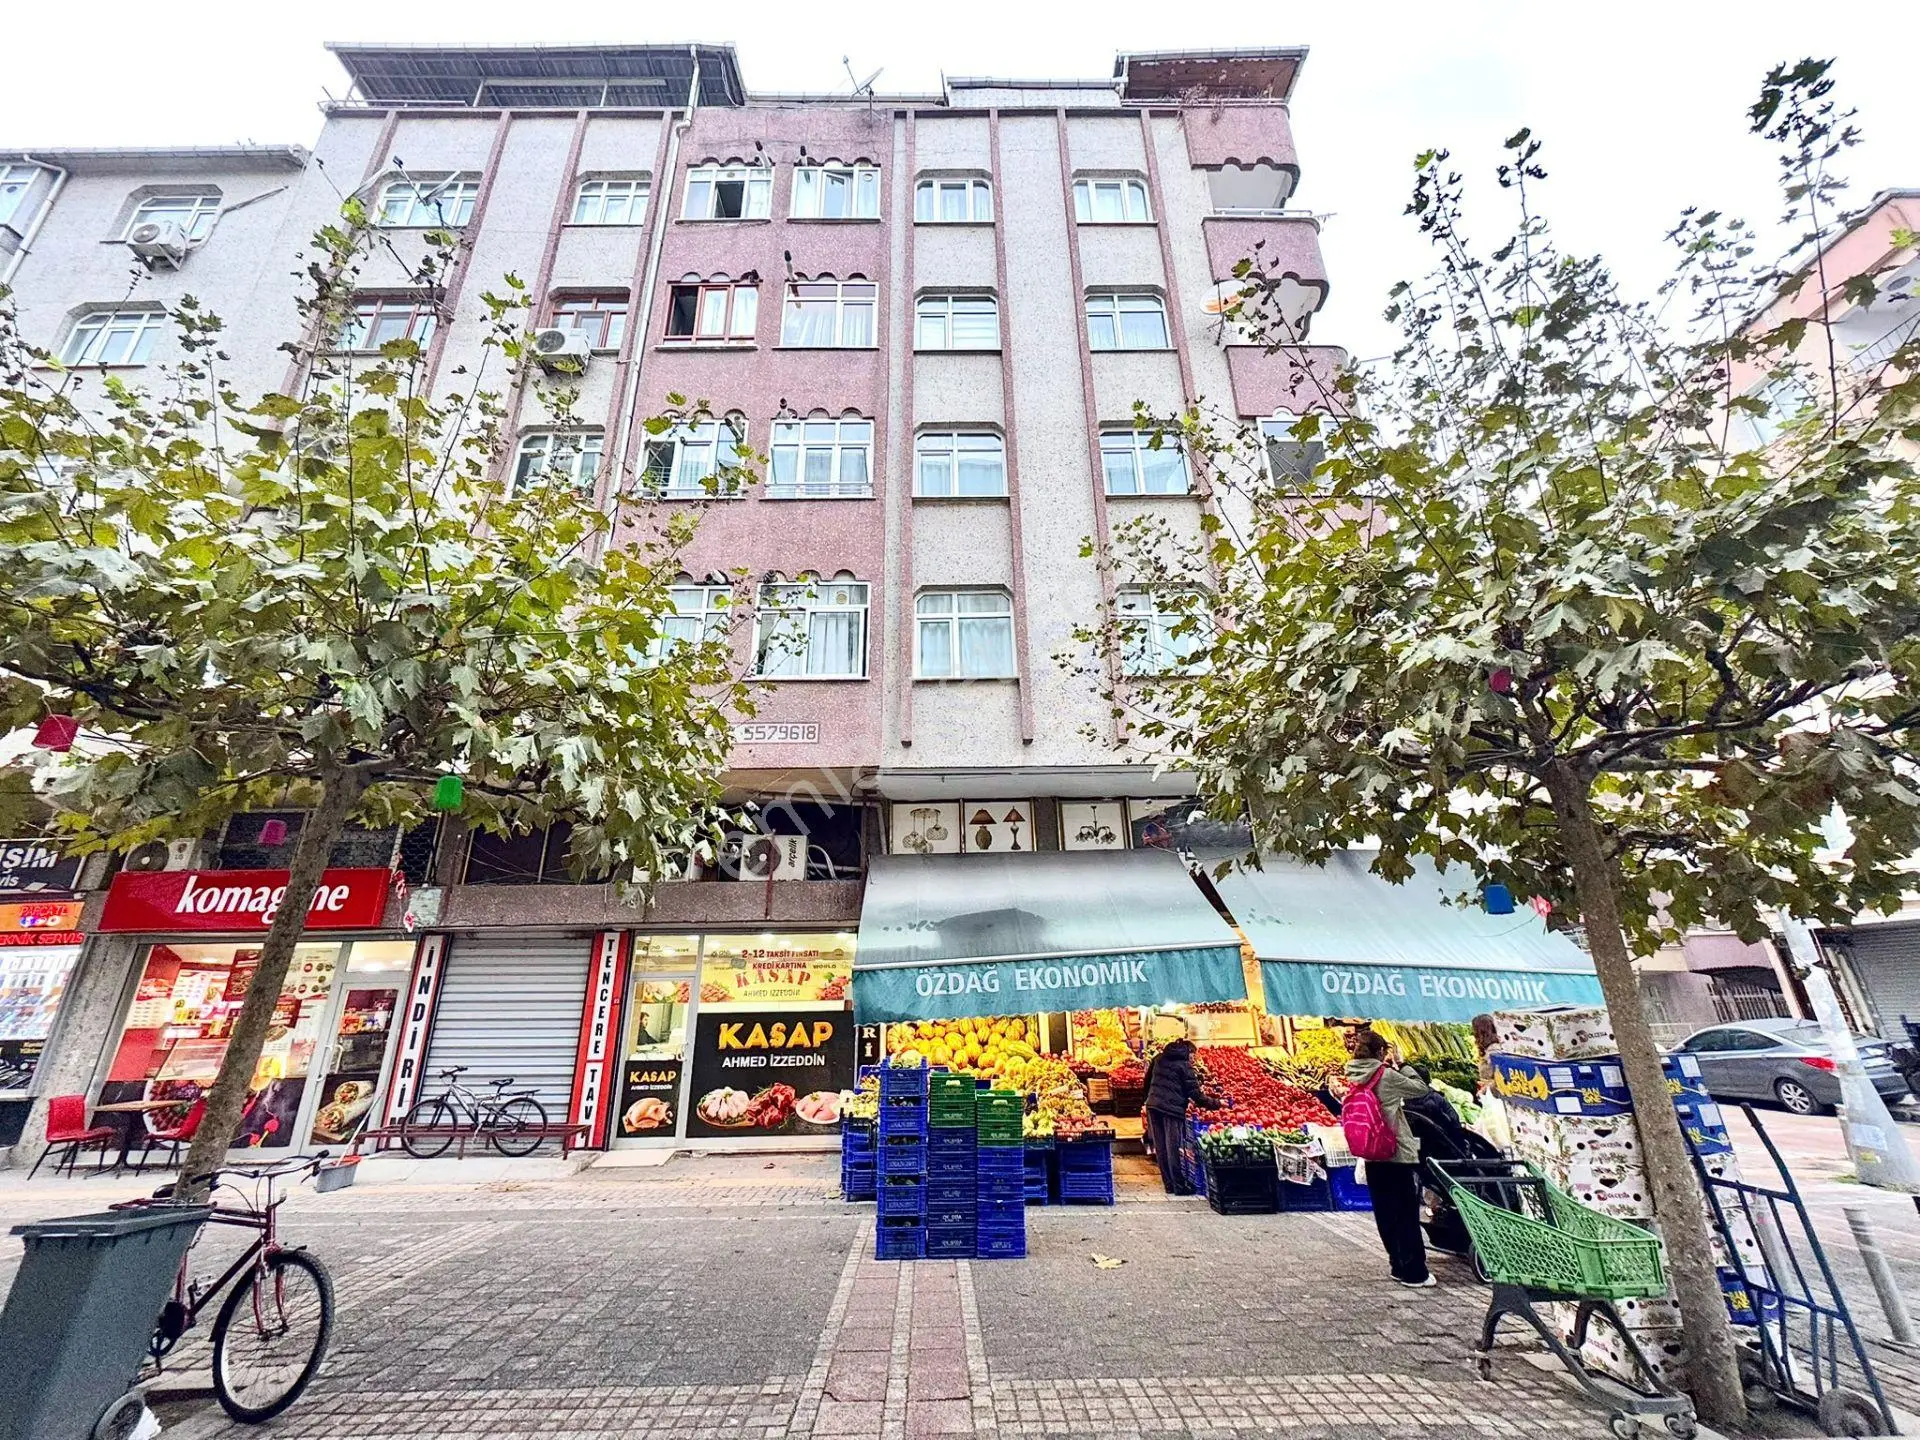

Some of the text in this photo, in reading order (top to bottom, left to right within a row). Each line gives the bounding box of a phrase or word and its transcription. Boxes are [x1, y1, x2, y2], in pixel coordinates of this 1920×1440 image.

[175, 875, 350, 925] komagne
[742, 949, 765, 958] 2-12
[767, 949, 790, 958] TAKSİT
[752, 961, 774, 969] KREDİ
[736, 969, 811, 988] KASAP
[915, 956, 1148, 997] ÖZDAĞ EKONOMİK
[1321, 965, 1551, 1002] ÖZDAĞ EKONOMİK
[594, 938, 615, 1054] TENCERE
[718, 1021, 834, 1050] KASAP
[722, 1053, 826, 1068] AHMED İZZEDDİN
[630, 1070, 677, 1083] KASAP
